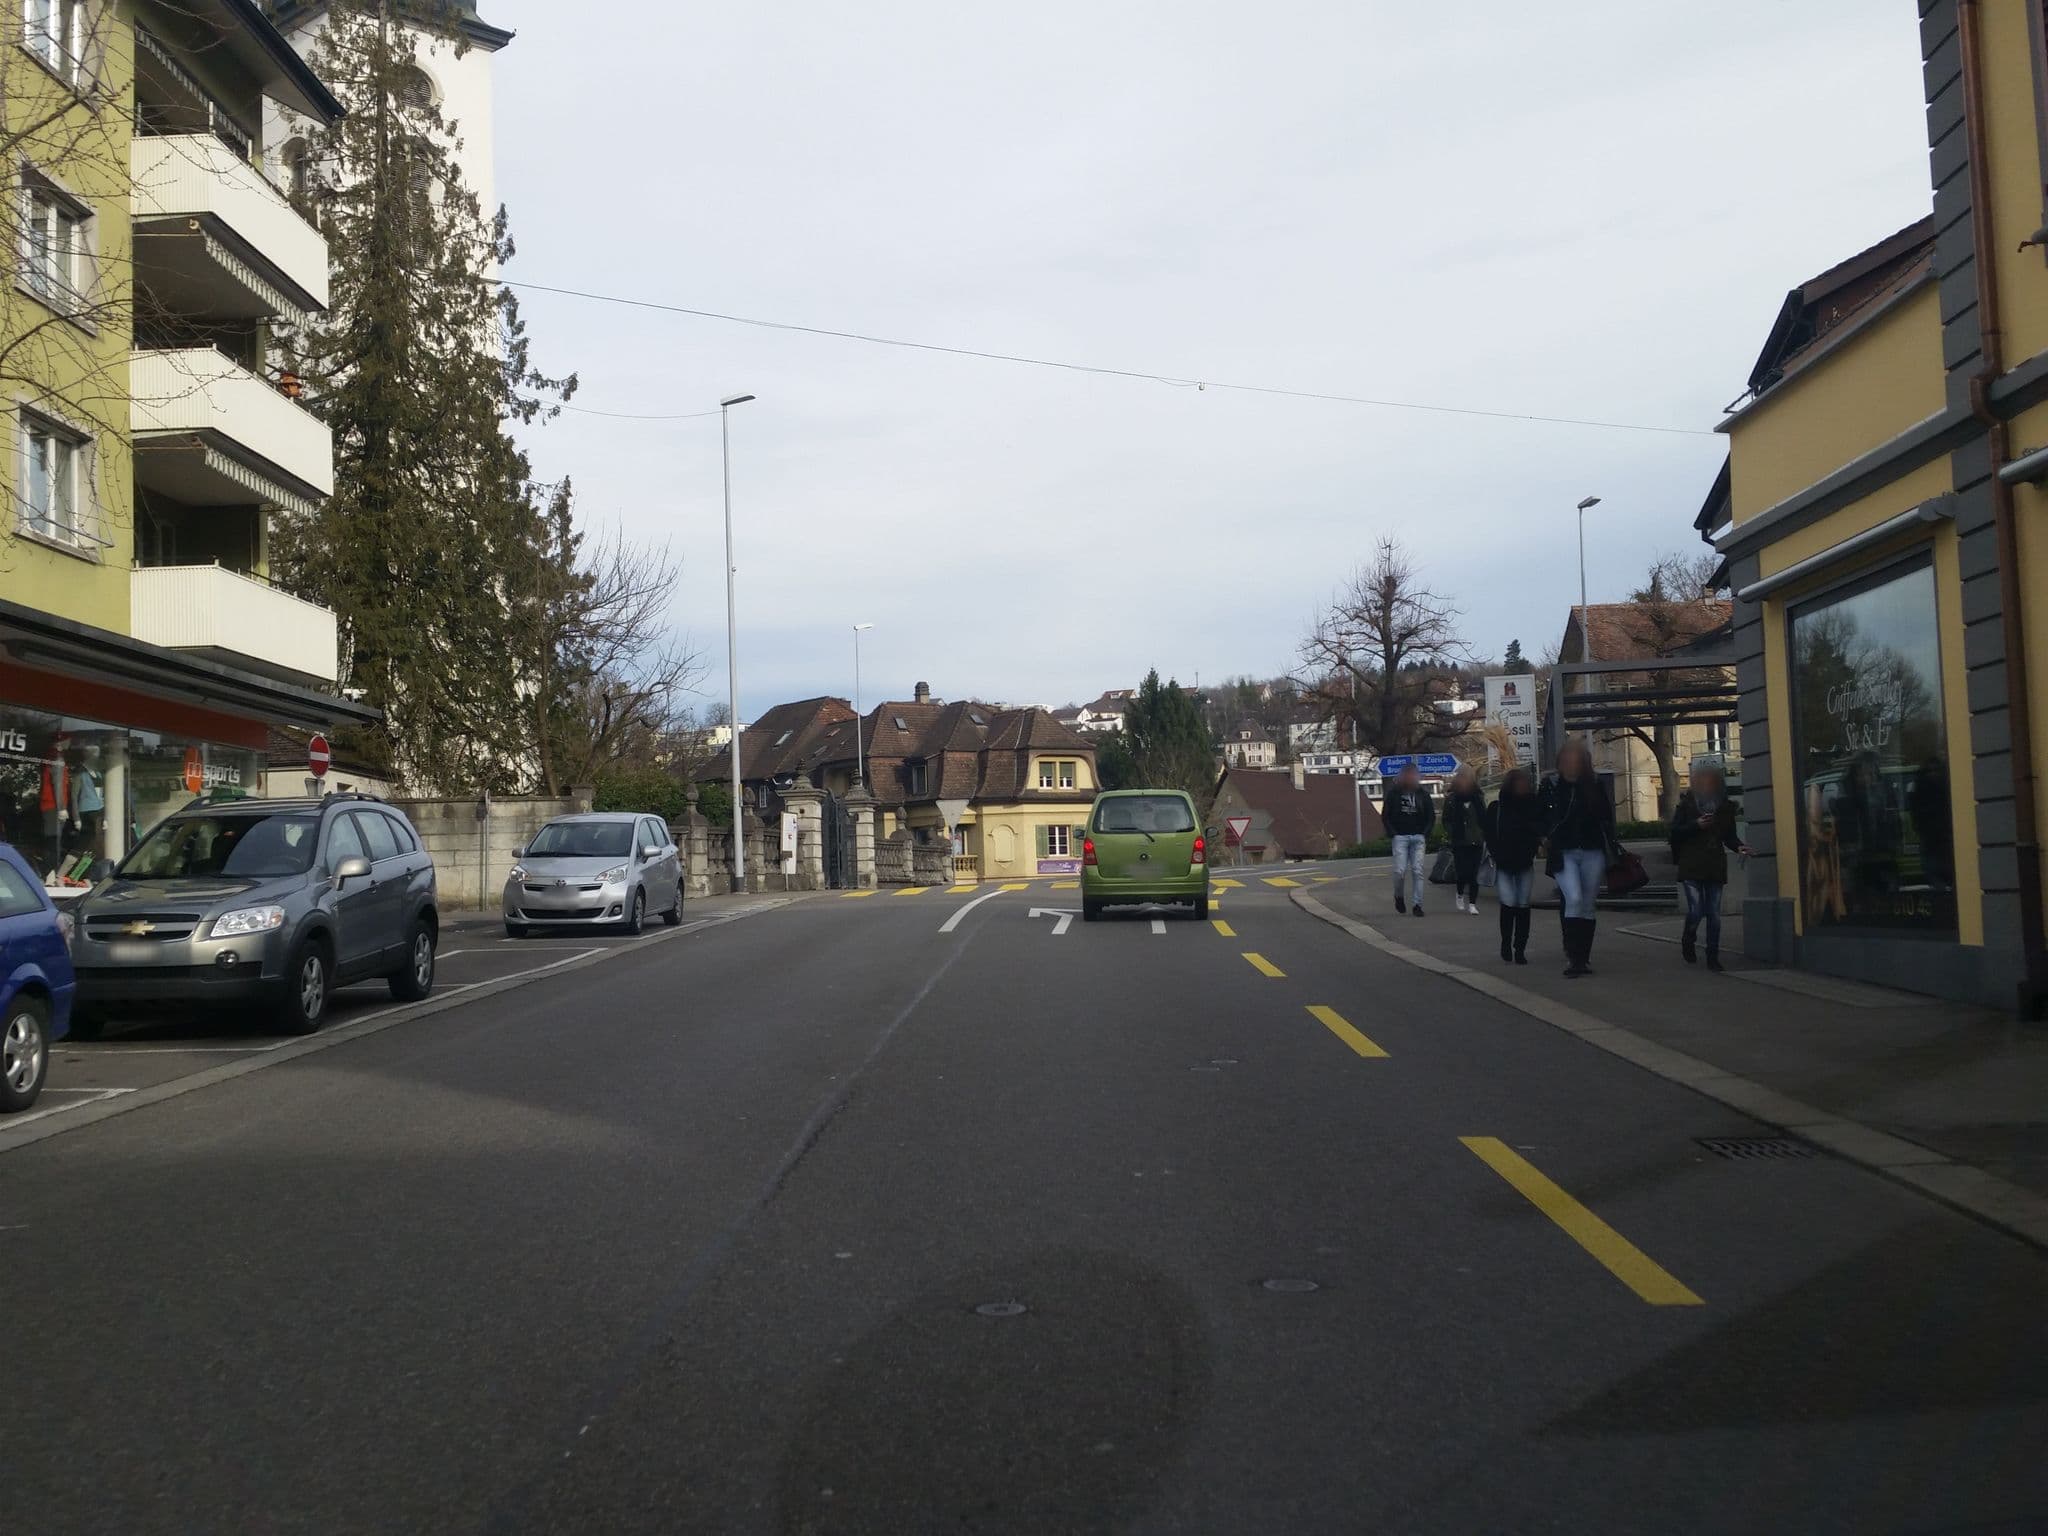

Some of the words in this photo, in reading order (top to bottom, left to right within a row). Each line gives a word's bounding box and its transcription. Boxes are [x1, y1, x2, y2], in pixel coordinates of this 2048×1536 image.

[1827, 680, 1865, 721] Coiffeur
[0, 728, 27, 752] rts
[1509, 724, 1532, 736] ssli
[1845, 722, 1860, 751] Sie
[1862, 723, 1873, 748] &
[1873, 716, 1892, 747] Er
[1426, 756, 1449, 764] Zürich
[202, 765, 241, 788] sports
